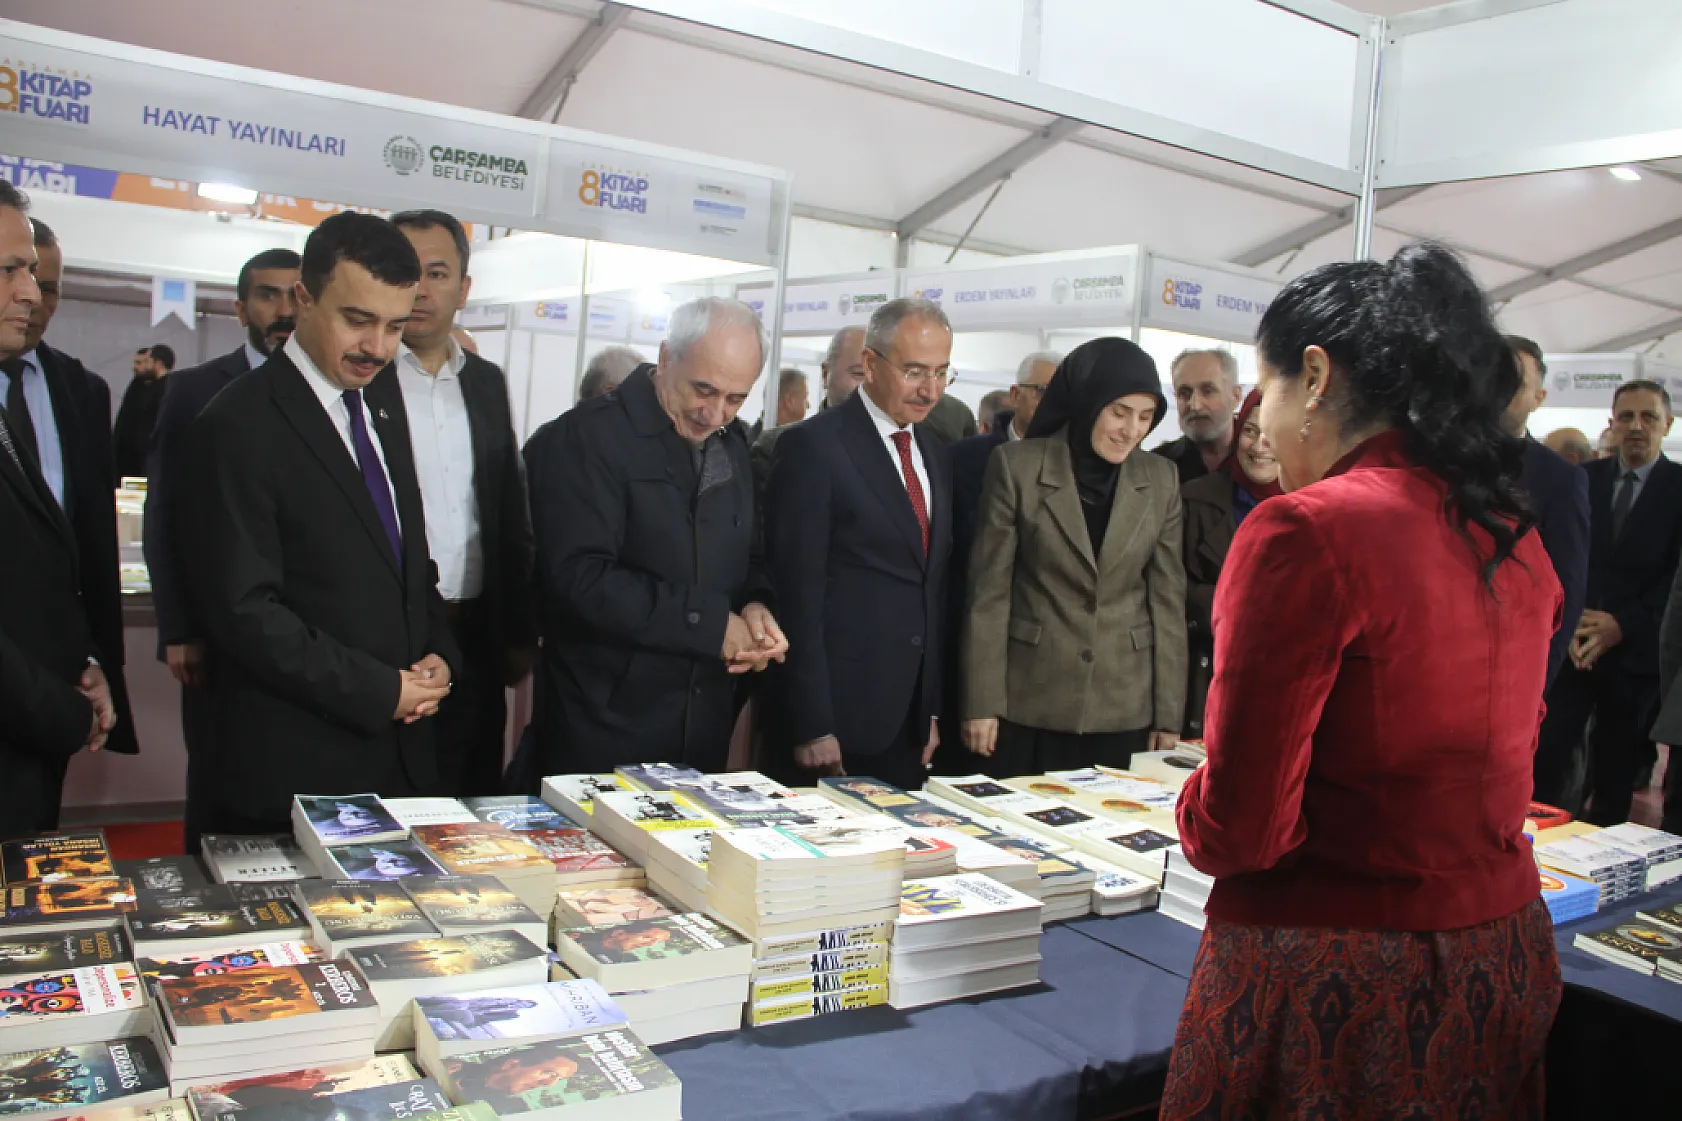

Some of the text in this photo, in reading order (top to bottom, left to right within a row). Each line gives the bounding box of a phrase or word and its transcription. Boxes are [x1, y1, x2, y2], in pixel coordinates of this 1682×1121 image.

[20, 69, 93, 100] KİTAP
[19, 94, 91, 125] FUARI
[143, 105, 221, 136] HAYAT
[228, 119, 346, 158] YAYINLARI
[429, 144, 529, 176] ÇARŞAMBA
[432, 164, 525, 190] BELEDİYESİ
[600, 172, 649, 194] KİTAP
[600, 191, 648, 214] FUARI
[1216, 293, 1253, 313] ERDEM
